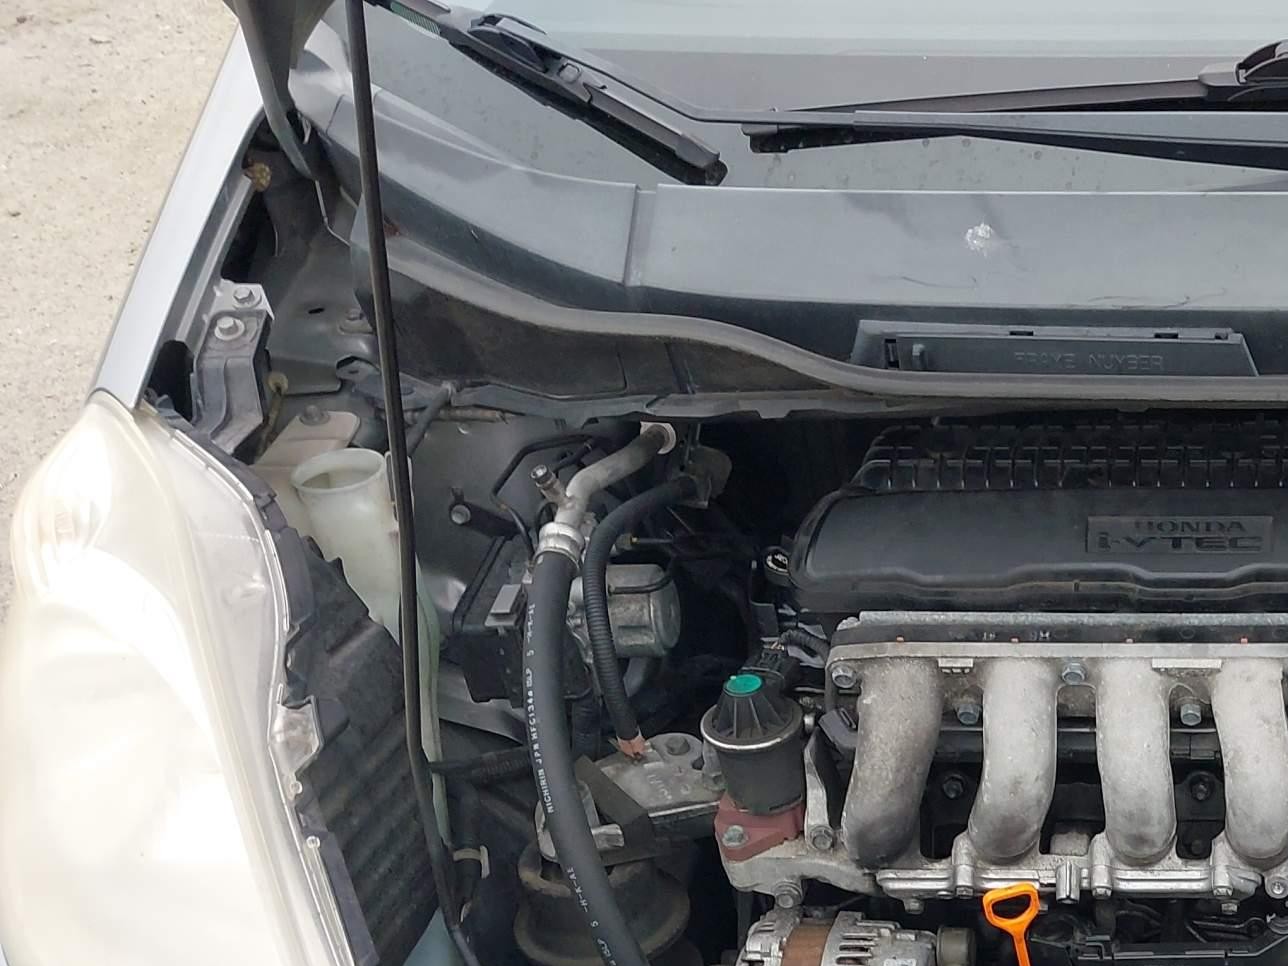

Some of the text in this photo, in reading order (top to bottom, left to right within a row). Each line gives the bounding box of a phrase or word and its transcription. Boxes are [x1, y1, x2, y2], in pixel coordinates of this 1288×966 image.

[1088, 352, 1165, 371] NUMBER
[1134, 520, 1247, 533] HONDA
[537, 769, 554, 813] NICHIRIN
